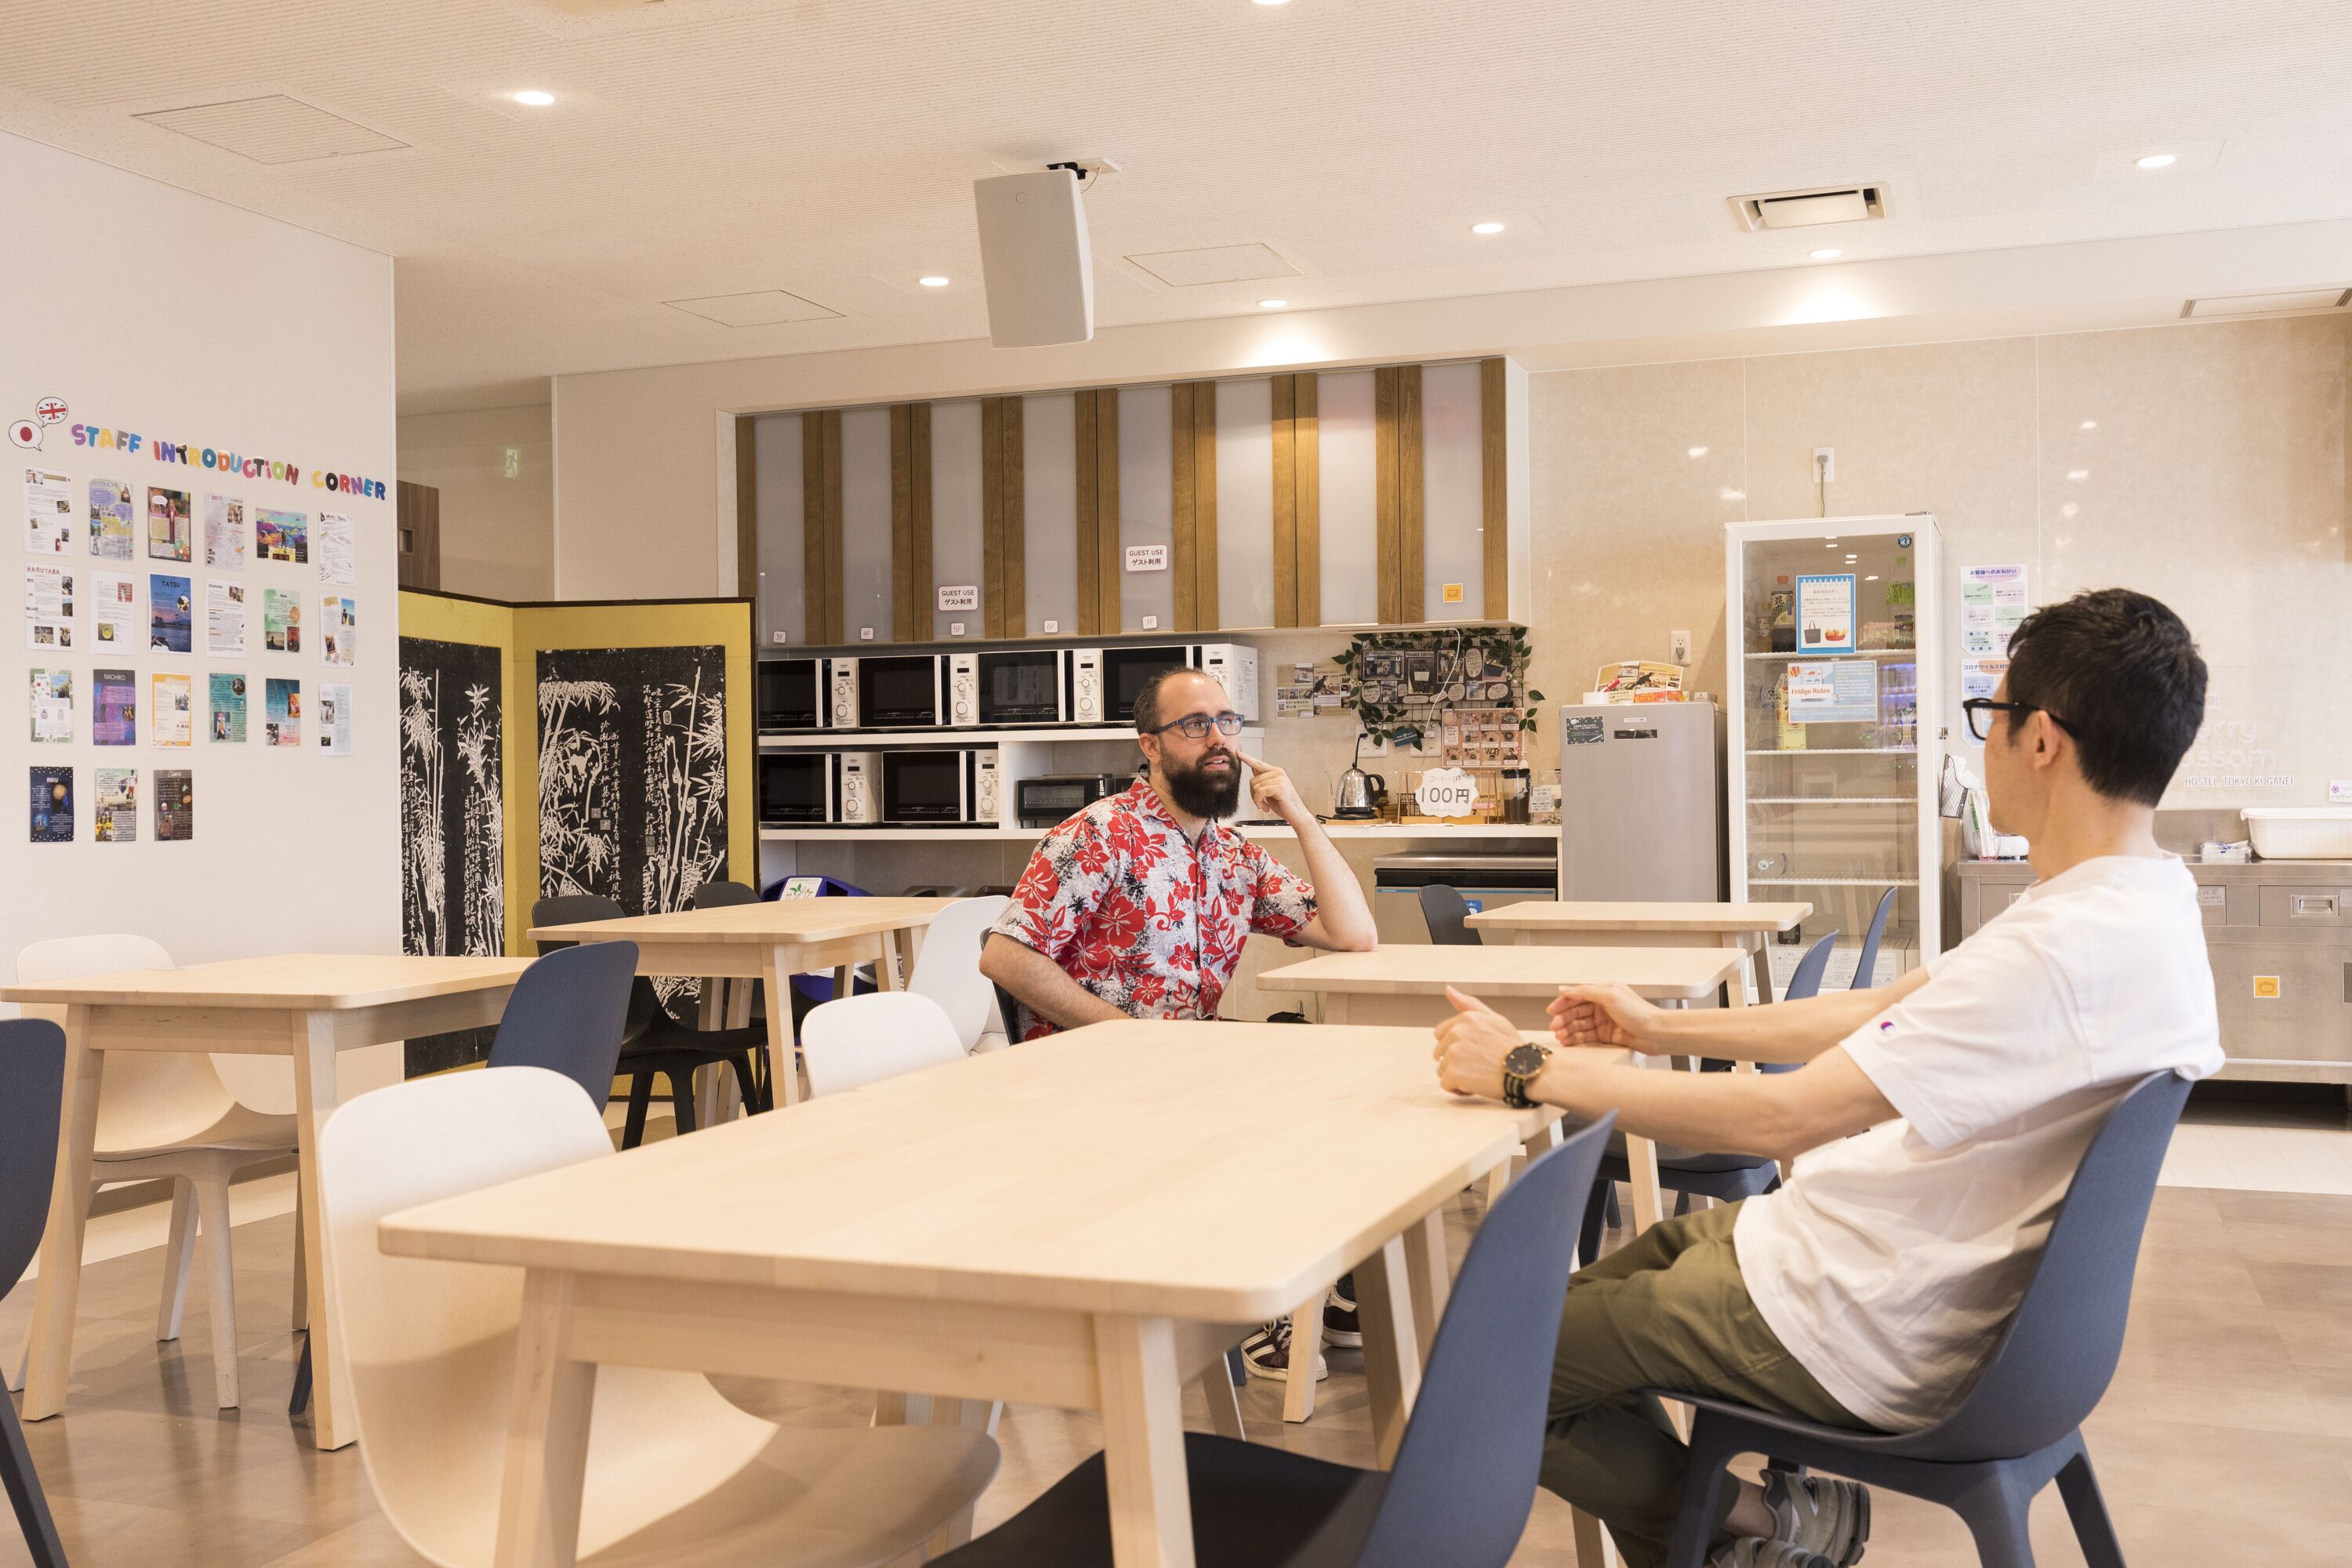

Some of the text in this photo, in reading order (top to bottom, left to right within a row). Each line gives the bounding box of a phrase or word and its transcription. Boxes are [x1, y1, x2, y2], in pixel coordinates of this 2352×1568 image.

[71, 423, 142, 454] STAFF
[311, 469, 387, 501] CORNER
[1131, 557, 1162, 566] ゲスト利用
[27, 565, 61, 575] HARUTAKA
[161, 580, 181, 589] TATSU
[2184, 776, 2294, 788] HOSTEL, TOKYO KOGANEI
[1421, 787, 1470, 804] 100円
